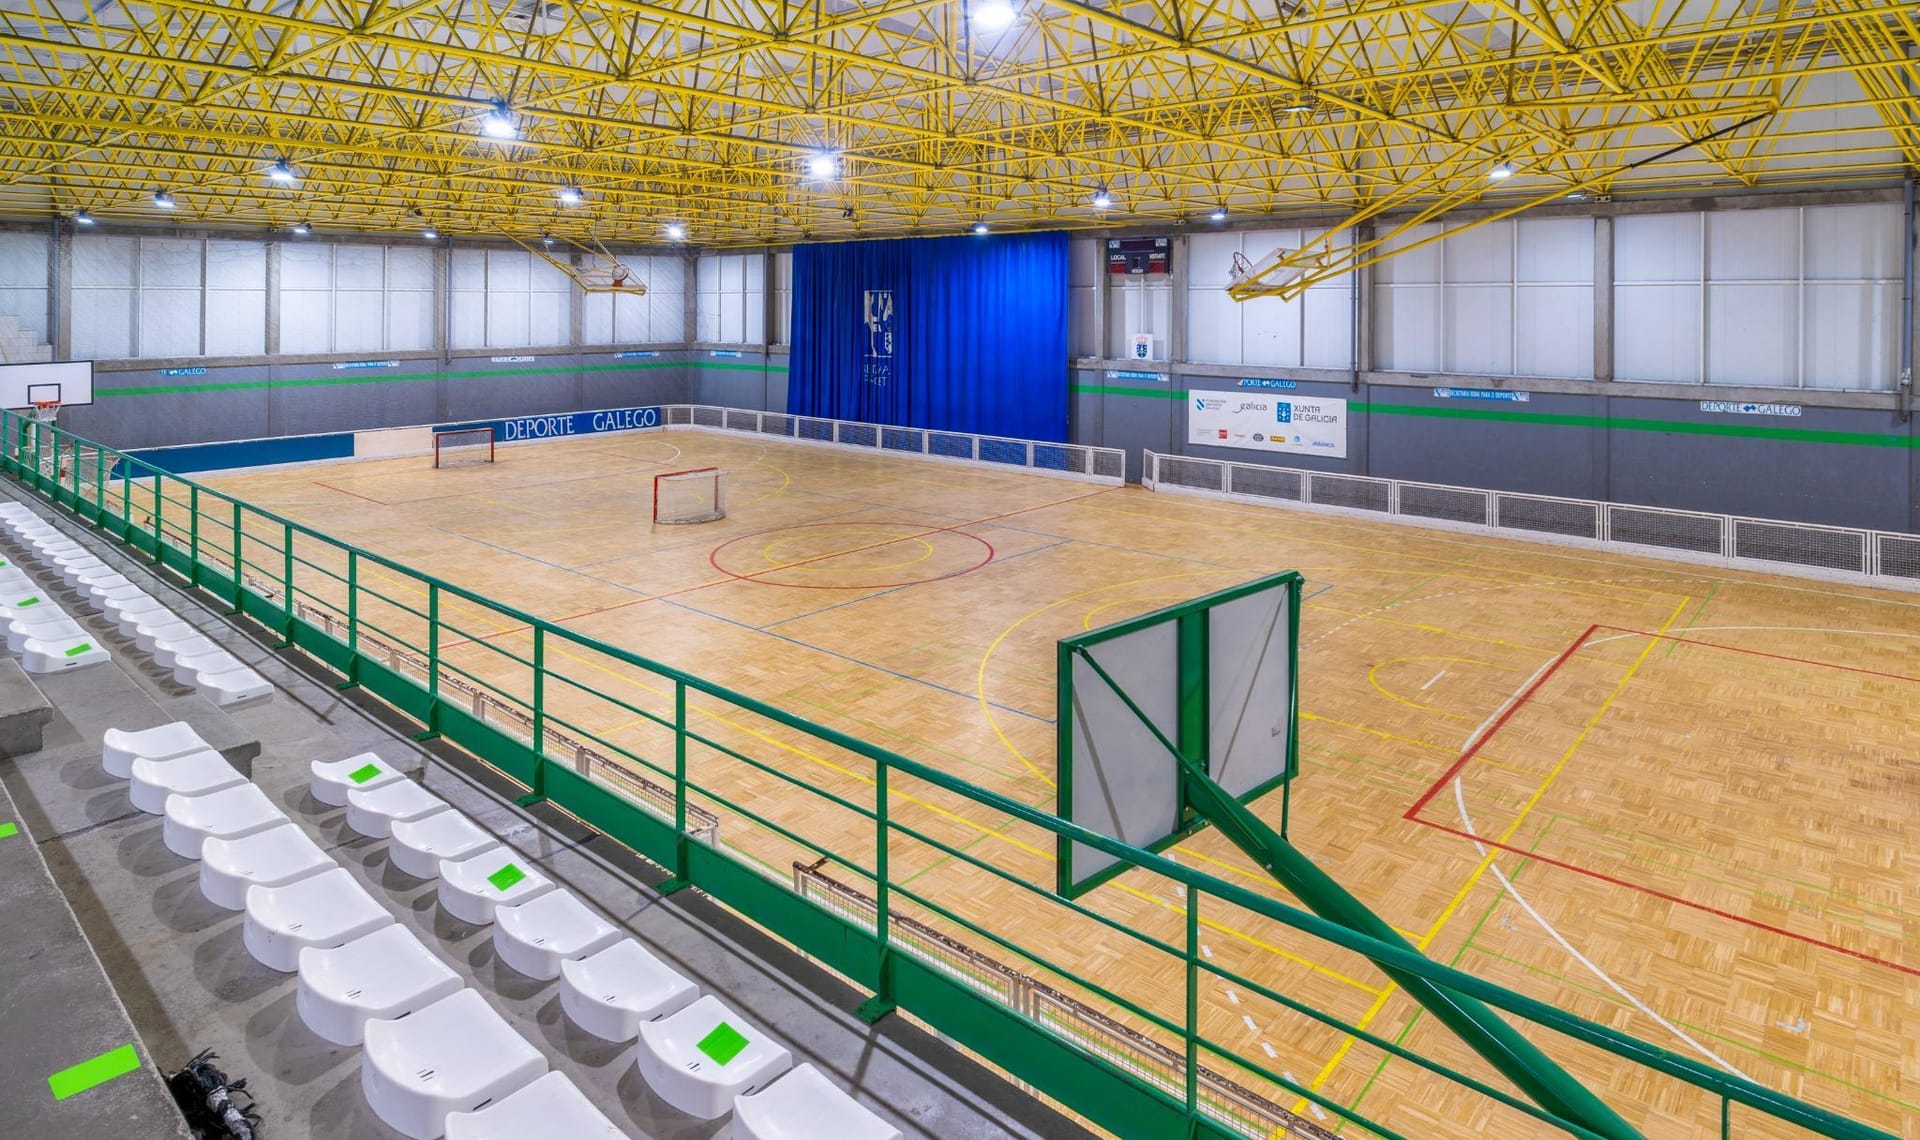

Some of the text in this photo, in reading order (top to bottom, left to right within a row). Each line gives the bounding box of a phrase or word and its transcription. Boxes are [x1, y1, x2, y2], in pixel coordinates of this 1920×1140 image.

[1270, 380, 1297, 389] GALEGO
[1232, 401, 1268, 413] galicia
[1293, 404, 1321, 413] XUNTA
[1701, 401, 1801, 416] DEPORTE GALEGO
[1293, 413, 1338, 424] DE GALICIA
[505, 408, 656, 441] DEPORTE GALEGO
